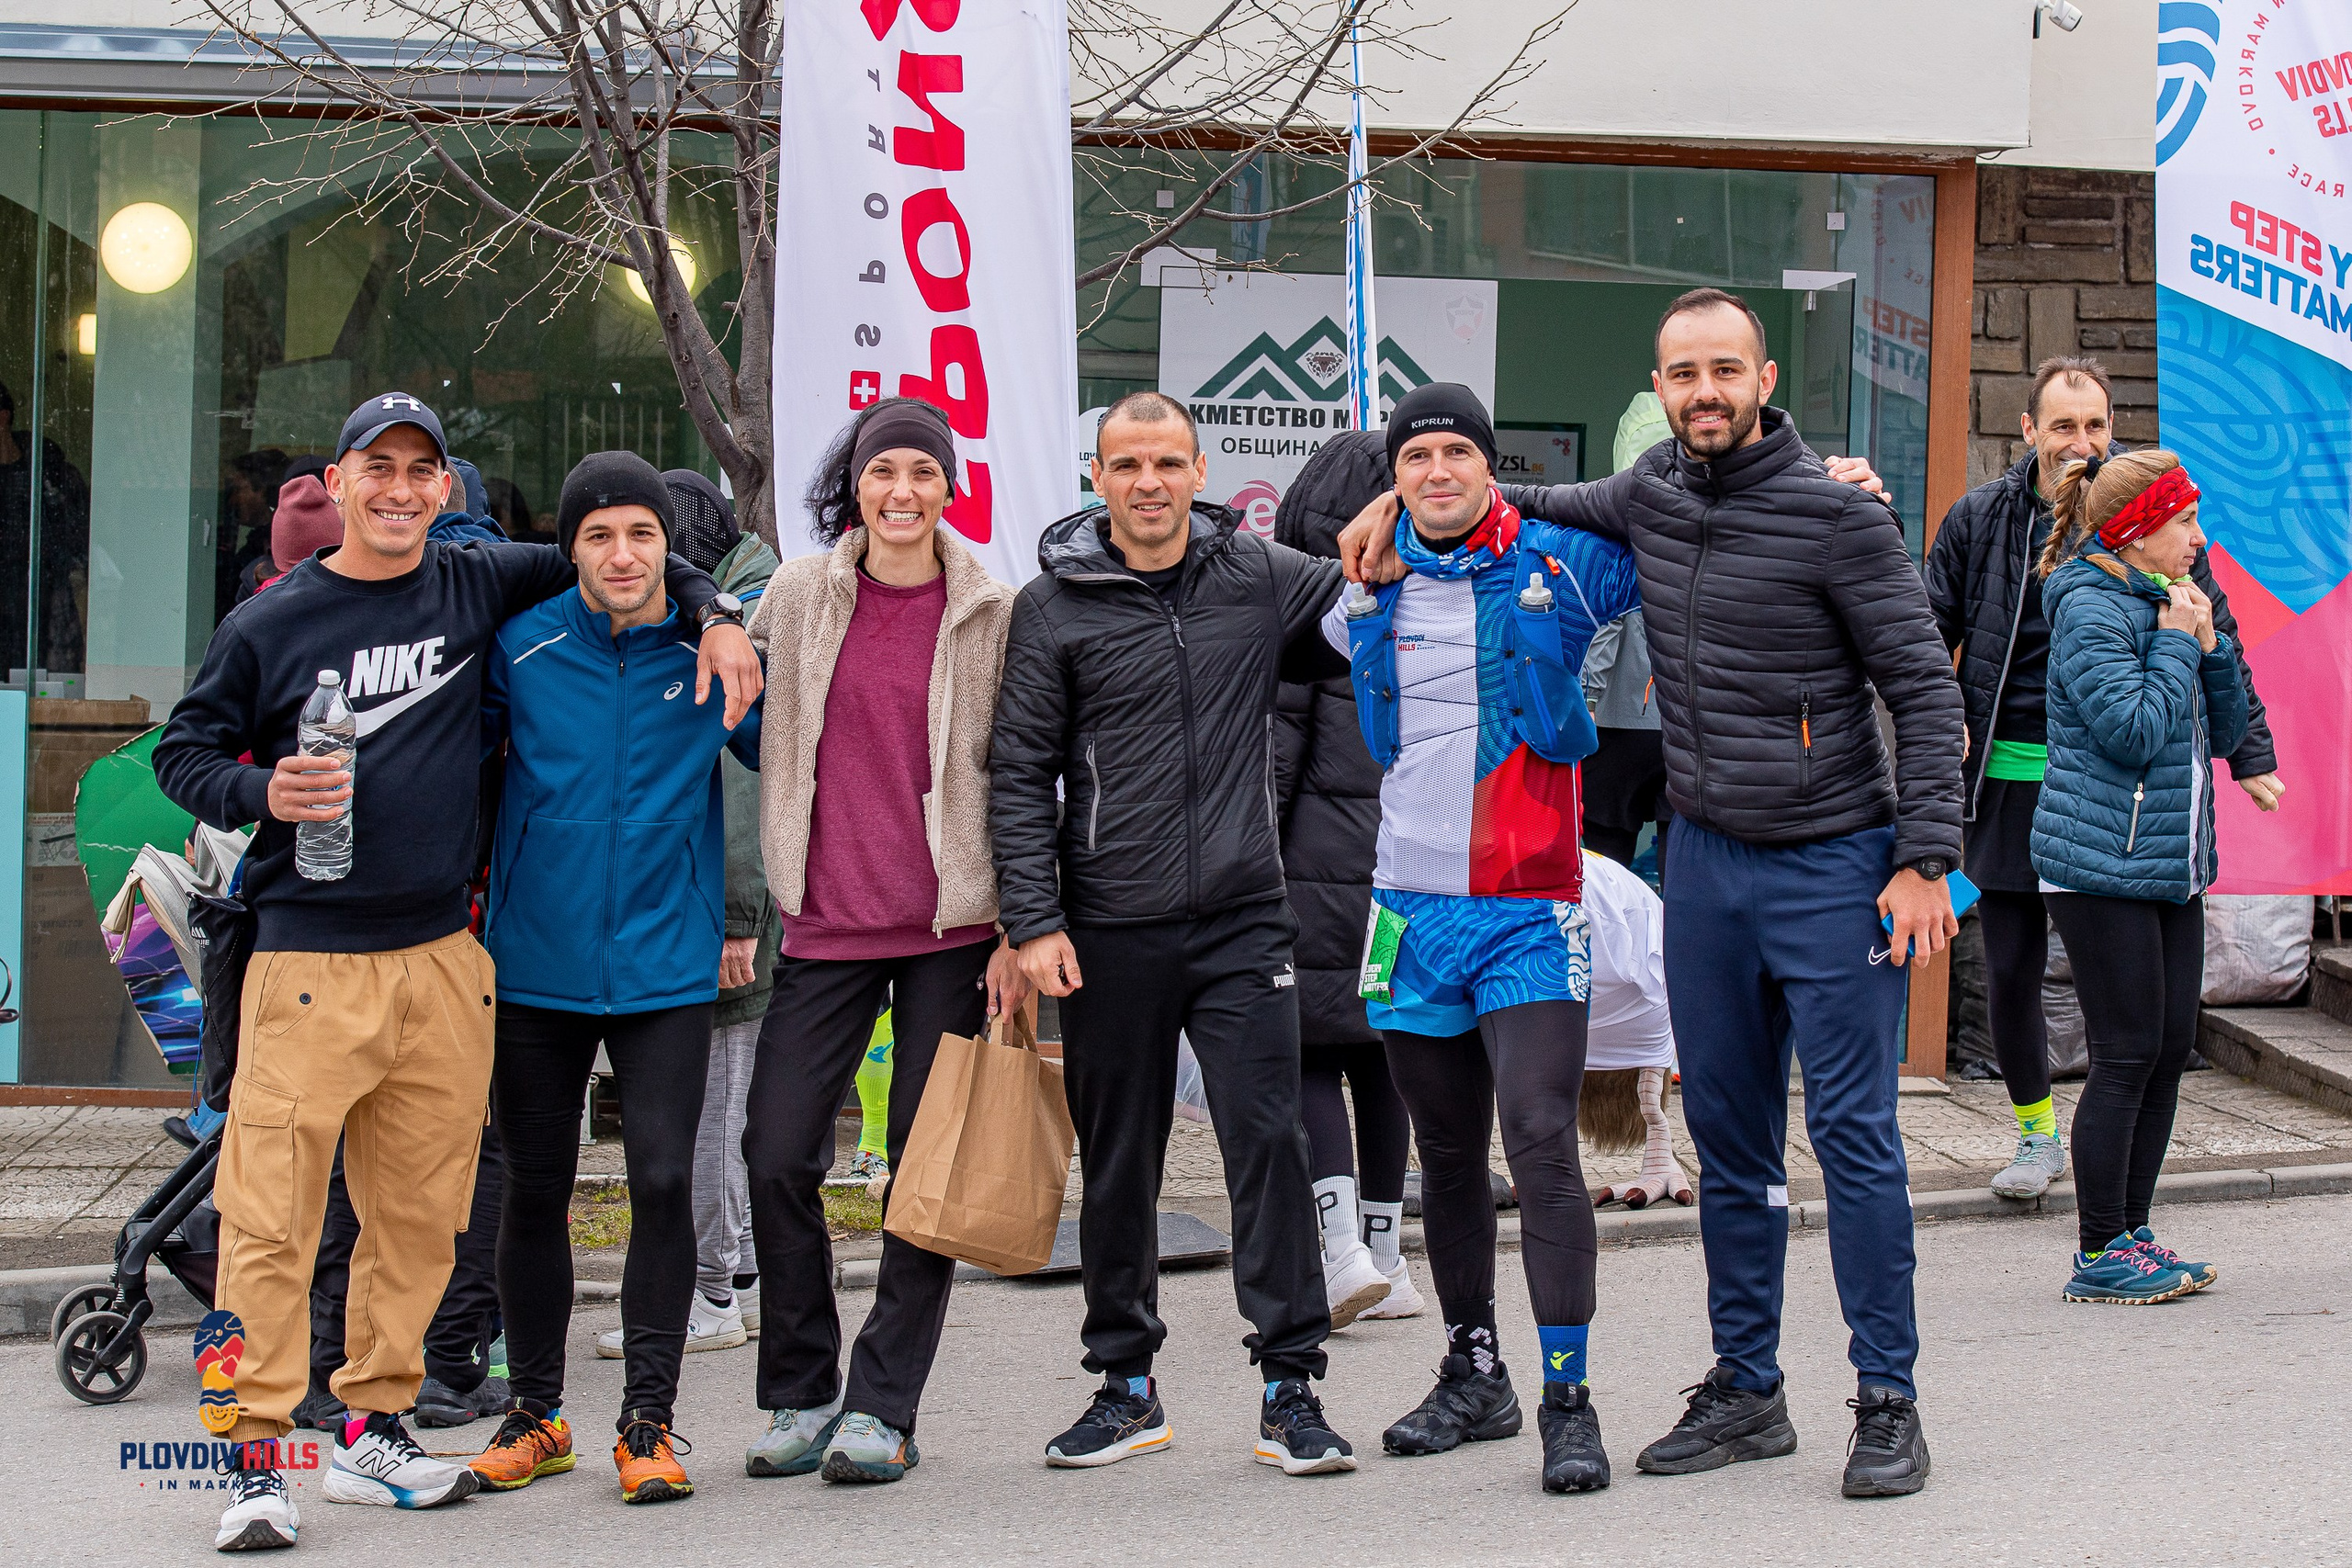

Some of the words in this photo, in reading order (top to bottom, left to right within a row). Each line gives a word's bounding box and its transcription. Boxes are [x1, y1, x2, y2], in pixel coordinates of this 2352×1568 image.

[1189, 404, 1326, 429] КМЕТСТВО
[1411, 417, 1453, 429] KIPRUN
[1220, 436, 1321, 458] ОБЩИНА
[1397, 643, 1417, 651] HILLS
[347, 635, 446, 699] NIKE
[1272, 974, 1295, 987] PUMA
[1363, 1213, 1393, 1249] P
